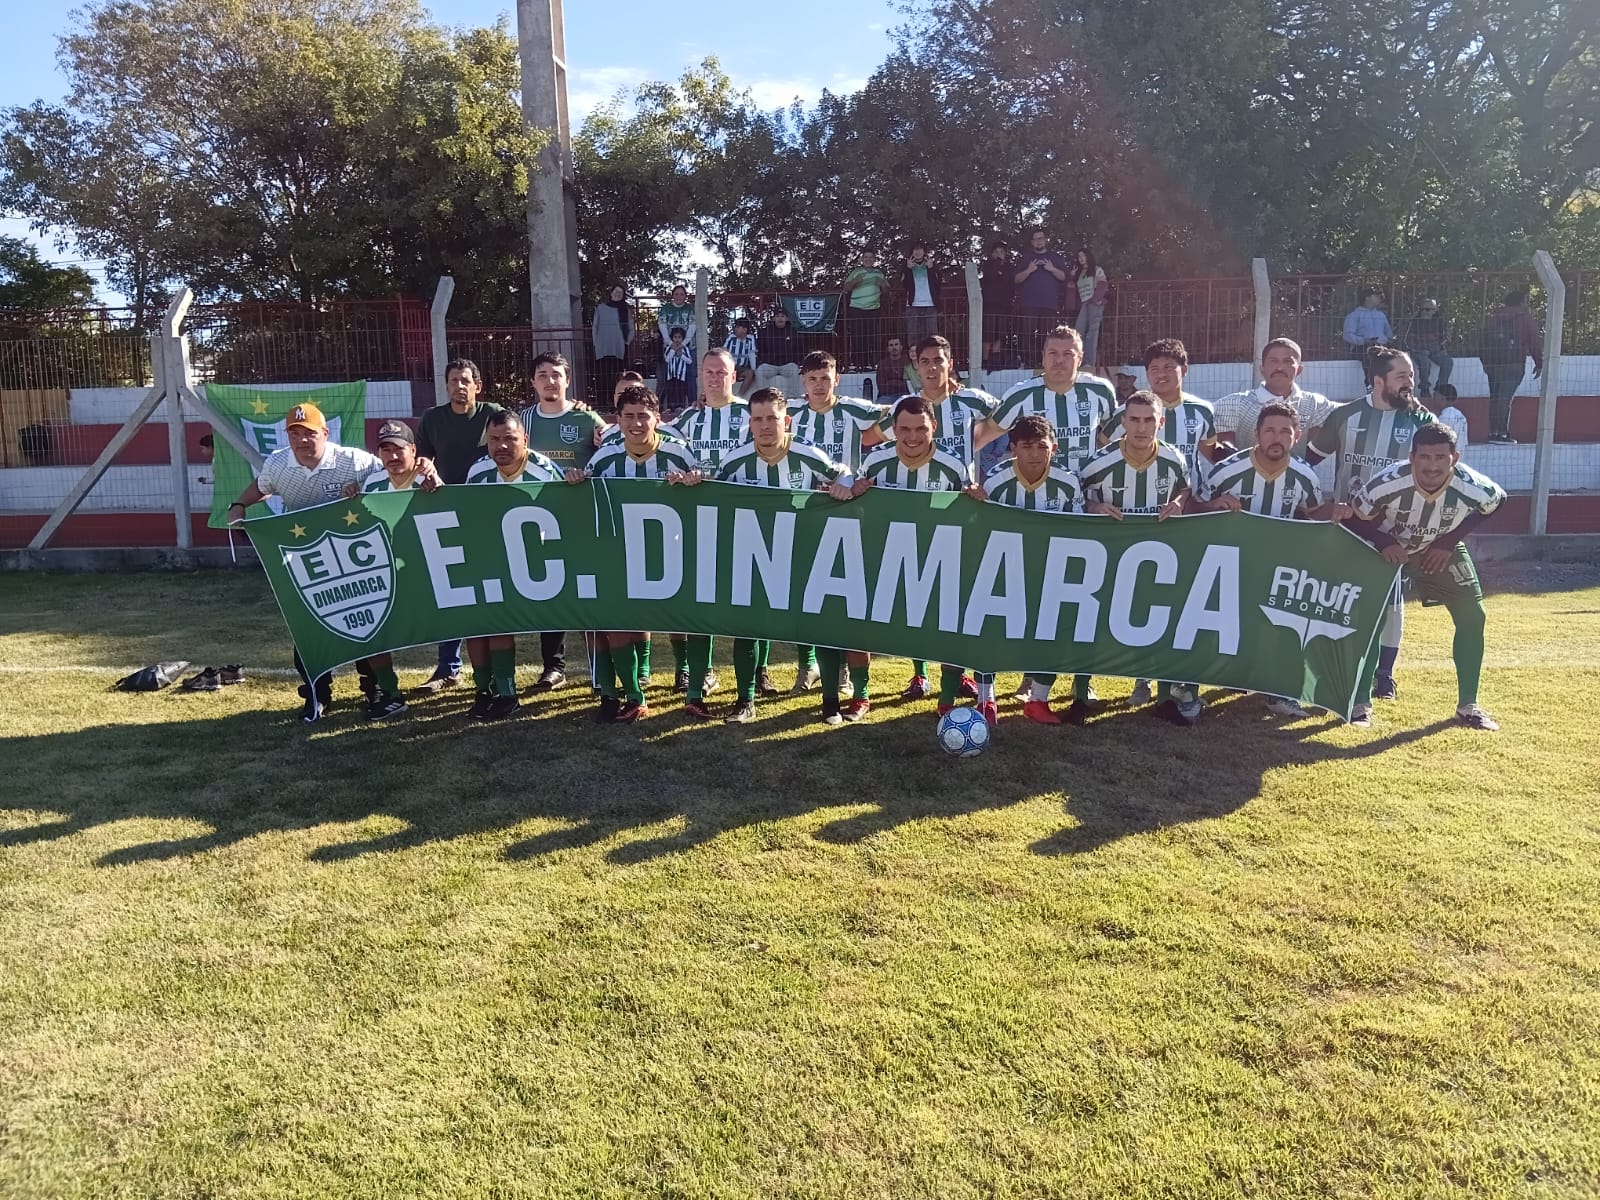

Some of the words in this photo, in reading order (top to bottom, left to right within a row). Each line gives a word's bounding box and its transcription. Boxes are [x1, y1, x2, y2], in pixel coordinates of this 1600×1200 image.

[692, 440, 741, 450] DINAMARCA
[1053, 427, 1091, 438] AMARCA
[413, 505, 597, 609] E.C.
[621, 503, 1240, 656] DINAMARCA
[1448, 561, 1474, 583] 10
[312, 575, 388, 609] DINAMARCA
[1270, 566, 1362, 614] Rhuff
[342, 608, 375, 630] 1990
[1268, 596, 1351, 625] SPORTS
